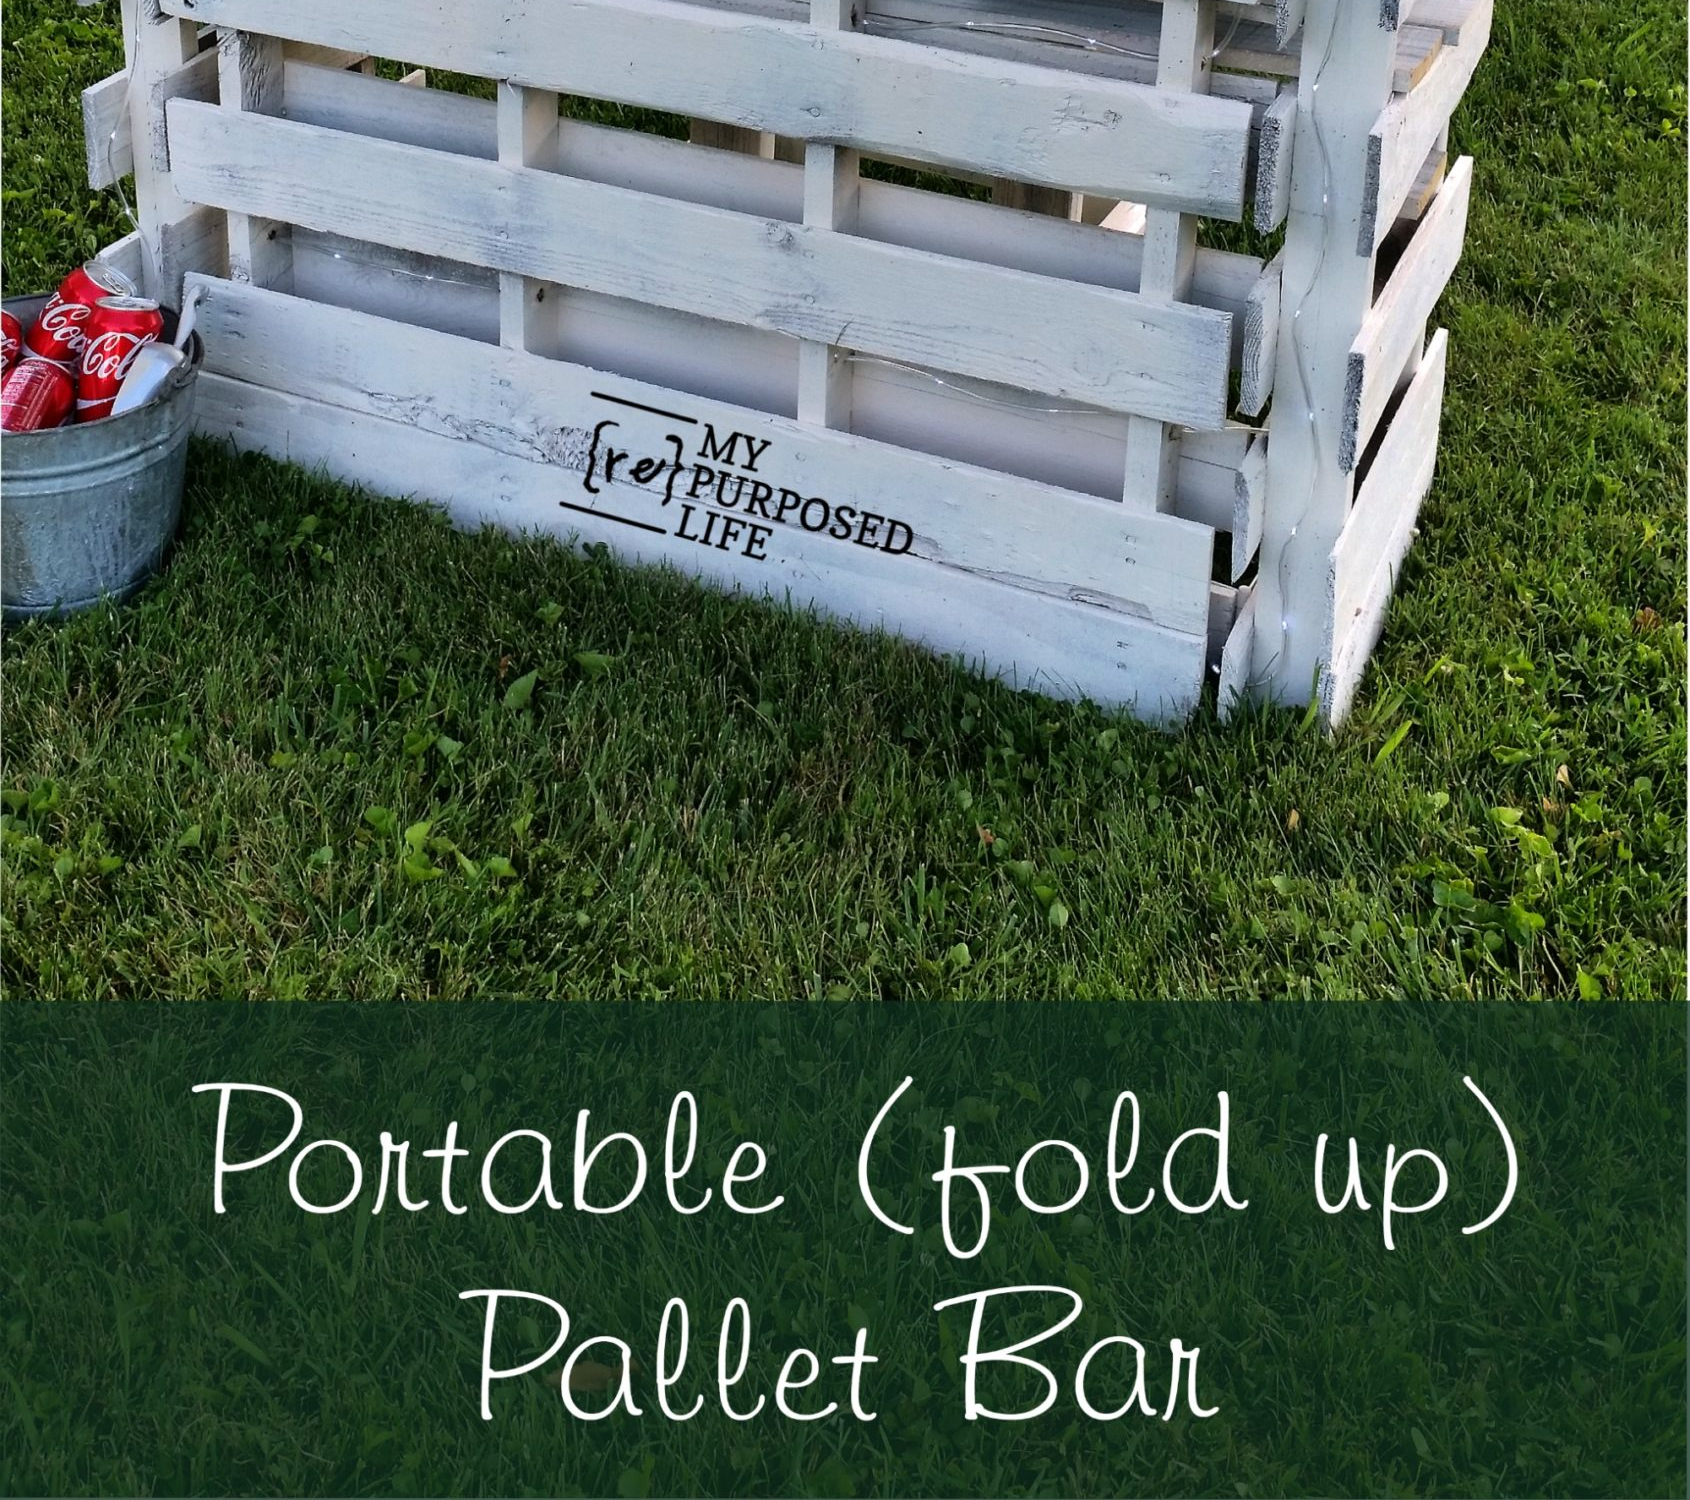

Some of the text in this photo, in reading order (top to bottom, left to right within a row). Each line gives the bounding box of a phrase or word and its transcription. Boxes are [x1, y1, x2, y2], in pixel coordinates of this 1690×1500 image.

[696, 423, 772, 472] MY
[673, 503, 774, 562] LIFE
[685, 462, 914, 555] PURPOSED
